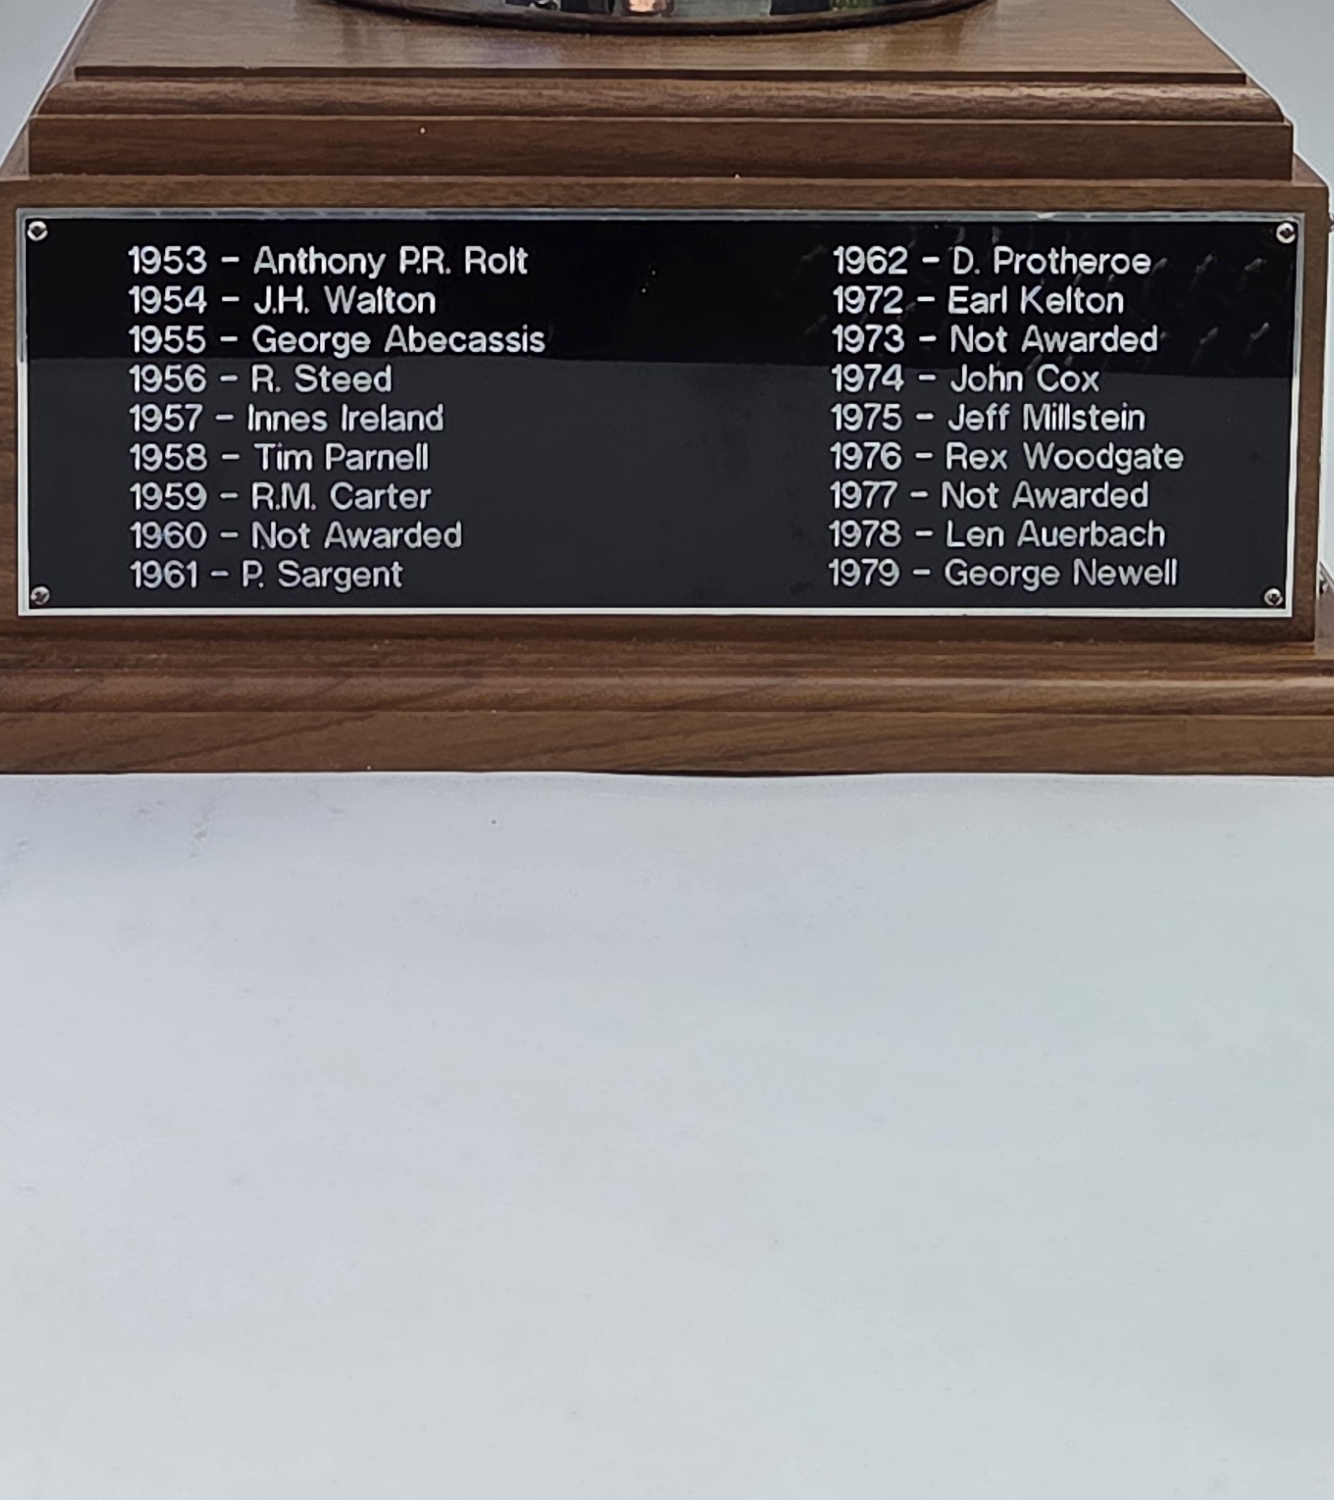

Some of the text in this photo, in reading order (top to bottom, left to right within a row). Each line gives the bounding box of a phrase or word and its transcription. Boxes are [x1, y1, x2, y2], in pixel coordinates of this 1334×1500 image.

[127, 245, 208, 275] 1953
[253, 245, 387, 280] Anthony
[399, 245, 451, 275] P.R.
[465, 245, 529, 275] Rolt
[833, 245, 908, 275] 1962
[953, 245, 980, 275] D.
[993, 245, 1152, 275] Protheroe
[128, 285, 208, 315] 1954
[253, 284, 310, 315] J.H.
[323, 285, 436, 315] Walton
[832, 285, 904, 315] 1972
[948, 285, 1008, 315] Earl
[1020, 285, 1124, 315] Kelton
[128, 324, 206, 354] 1955
[252, 324, 372, 359] George
[384, 324, 546, 353] Abecassis
[831, 323, 905, 354] 1973
[950, 324, 1008, 353] Not
[1021, 324, 1158, 353] Awarded
[128, 363, 207, 393] 1956
[251, 364, 281, 393] R.
[294, 363, 392, 393] Steed
[831, 363, 905, 393] 1974
[950, 363, 1024, 393] John
[1036, 363, 1100, 392] Cox
[129, 403, 203, 433] 1957
[247, 403, 328, 432] Innes
[341, 403, 444, 432] Ireland
[830, 402, 903, 432] 1975
[947, 402, 1011, 431] Jeff
[1023, 401, 1146, 431] Millstein
[129, 443, 208, 472] 1958
[253, 442, 313, 471] Tim
[325, 442, 429, 471] Parnell
[829, 441, 902, 471] 1976
[946, 441, 1008, 471] Rex
[1023, 441, 1184, 475] Woodgate
[129, 481, 208, 511] 1959
[252, 481, 317, 511] R.M.
[330, 481, 432, 511] Carter
[829, 480, 898, 509] 1977
[941, 480, 1000, 509] Not
[1012, 480, 1149, 509] Awarded
[129, 521, 207, 549] 1960
[252, 521, 311, 549] Not
[324, 520, 462, 549] Awarded
[828, 519, 902, 548] 1978
[946, 519, 1005, 548] Len
[1017, 519, 1166, 547] Auerbach
[129, 559, 197, 589] 1961
[242, 559, 264, 588] P.
[278, 559, 404, 593] Sargent
[828, 558, 900, 587] 1979
[944, 558, 1061, 592] George
[1073, 558, 1178, 586] Newell
